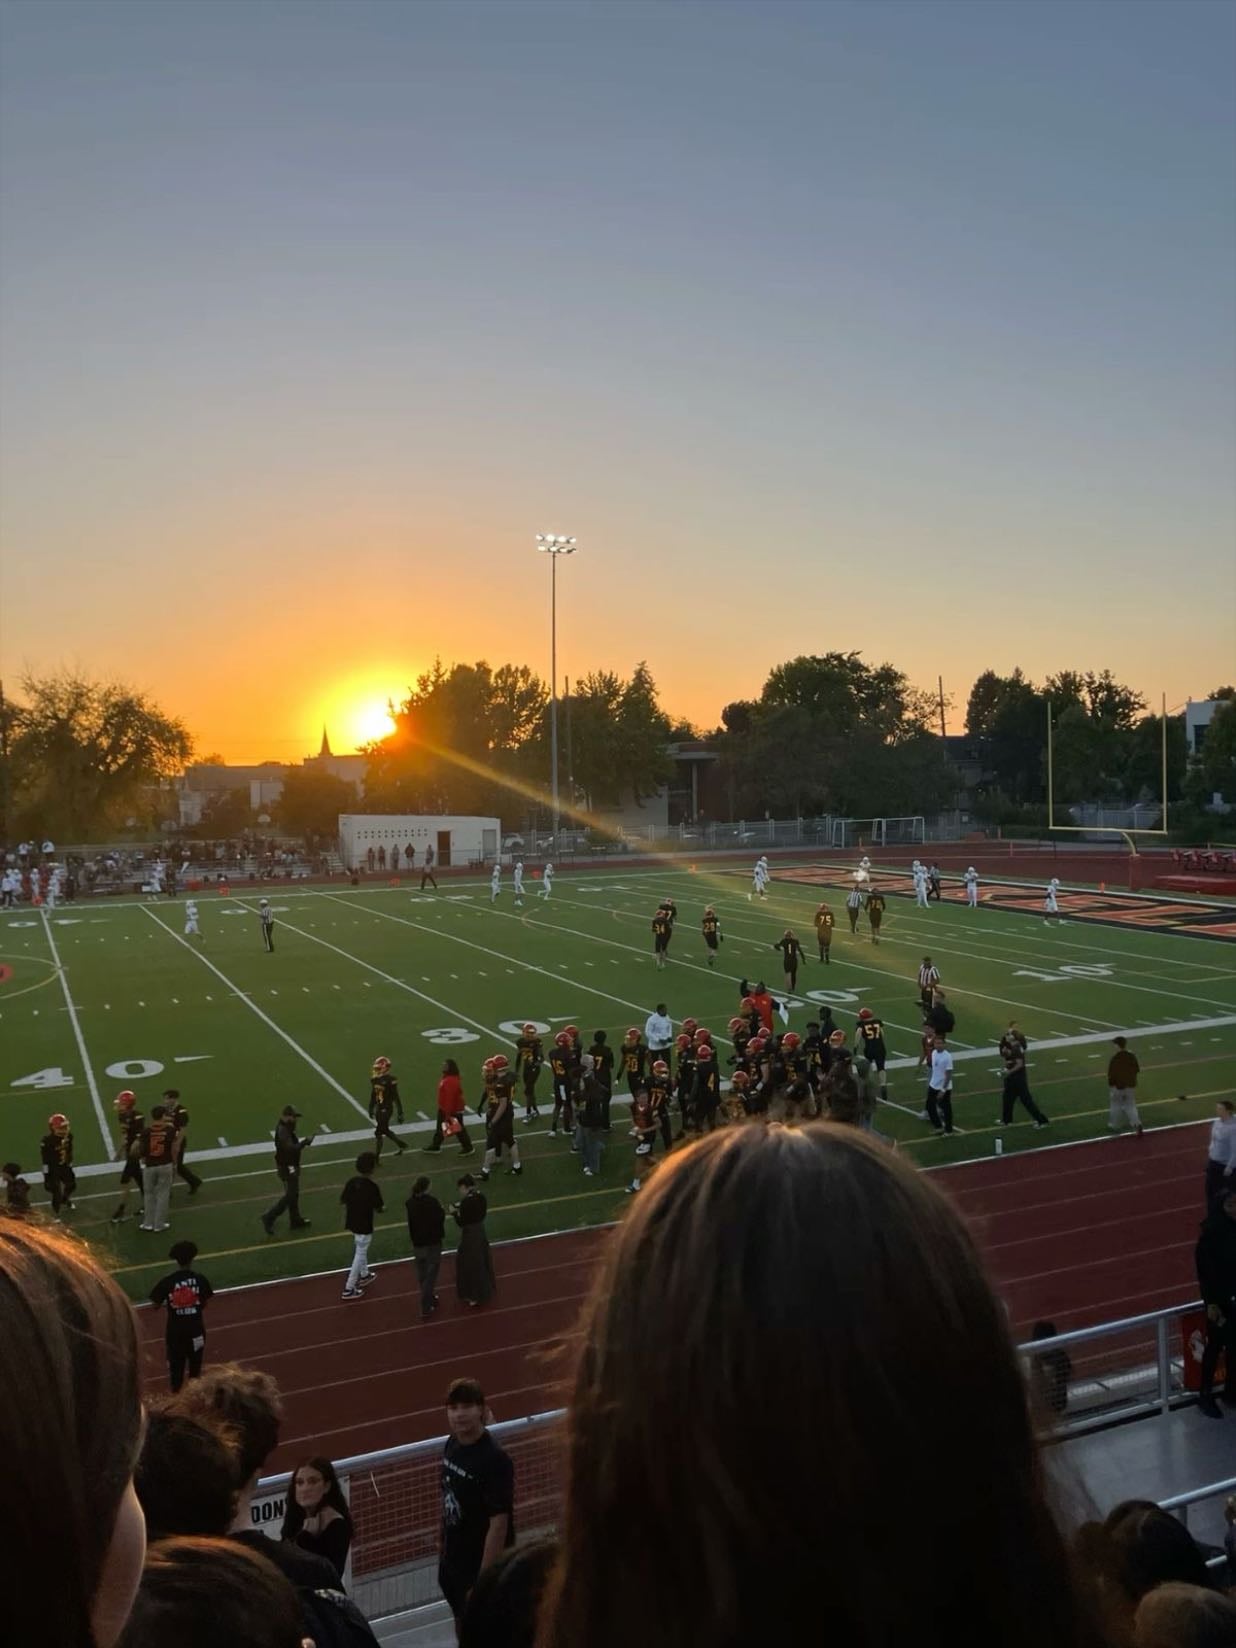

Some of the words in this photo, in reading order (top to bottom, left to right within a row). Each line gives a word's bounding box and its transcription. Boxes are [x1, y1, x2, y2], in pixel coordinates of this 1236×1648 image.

[864, 1023, 881, 1040] 57
[10, 1060, 164, 1088] 40
[706, 1071, 715, 1092] 4
